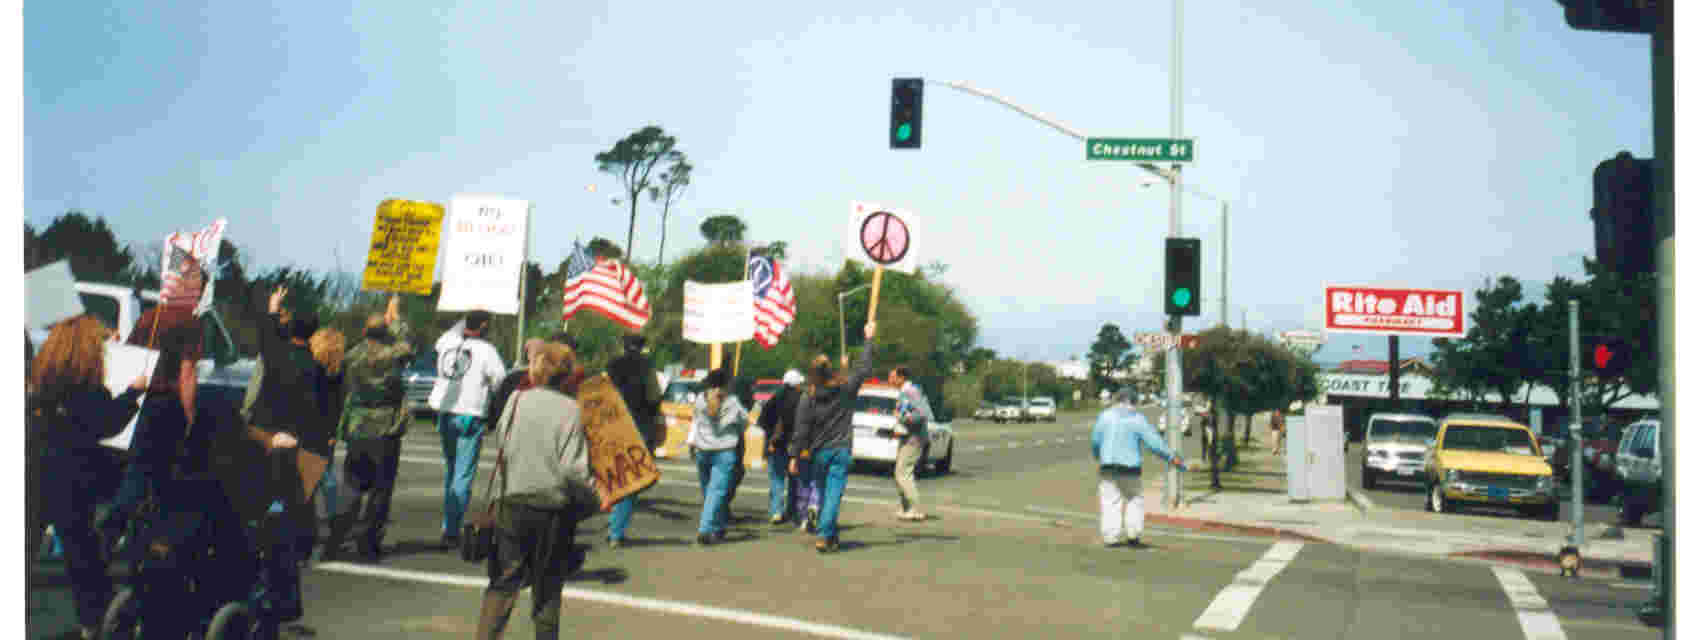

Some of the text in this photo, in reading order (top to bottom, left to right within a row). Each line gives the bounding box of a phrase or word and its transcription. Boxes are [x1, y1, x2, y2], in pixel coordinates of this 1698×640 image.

[1092, 143, 1187, 157] Chestnut St
[1331, 291, 1457, 315] Rite Aid
[594, 444, 657, 493] WAR
